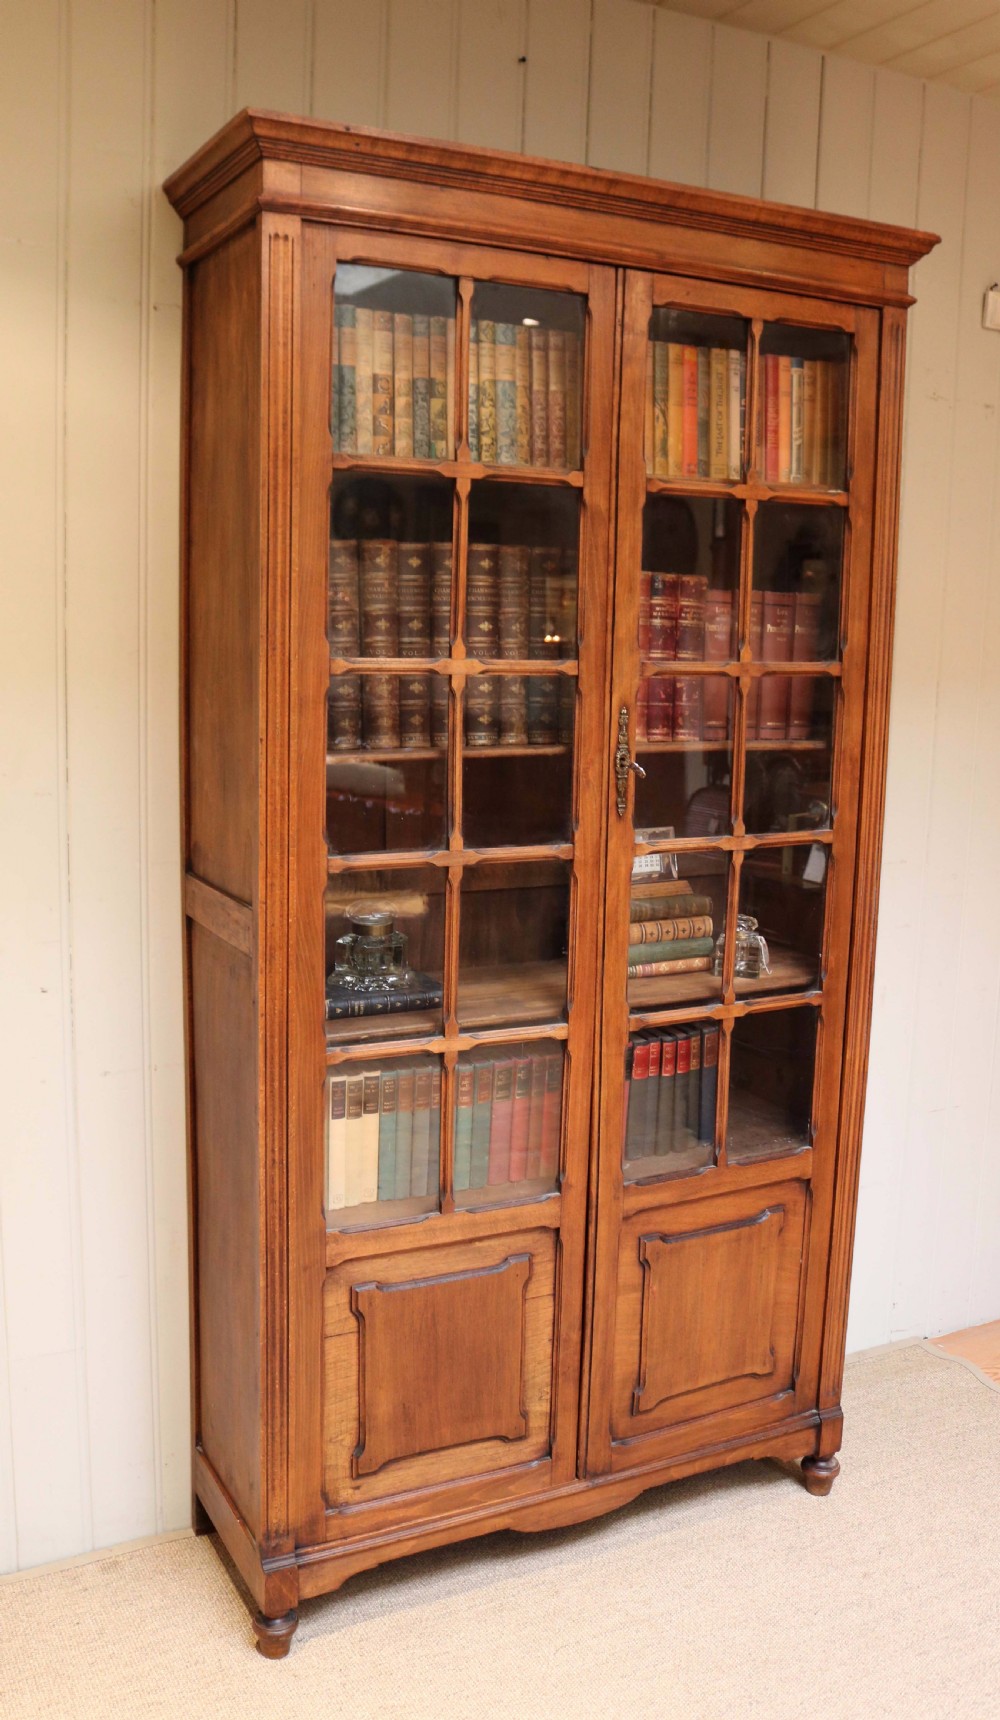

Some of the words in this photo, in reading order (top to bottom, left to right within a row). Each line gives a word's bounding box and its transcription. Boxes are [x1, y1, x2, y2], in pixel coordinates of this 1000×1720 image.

[715, 394, 724, 409] THE
[715, 410, 724, 421] OF
[715, 423, 724, 440] LAST
[715, 441, 724, 457] THE
